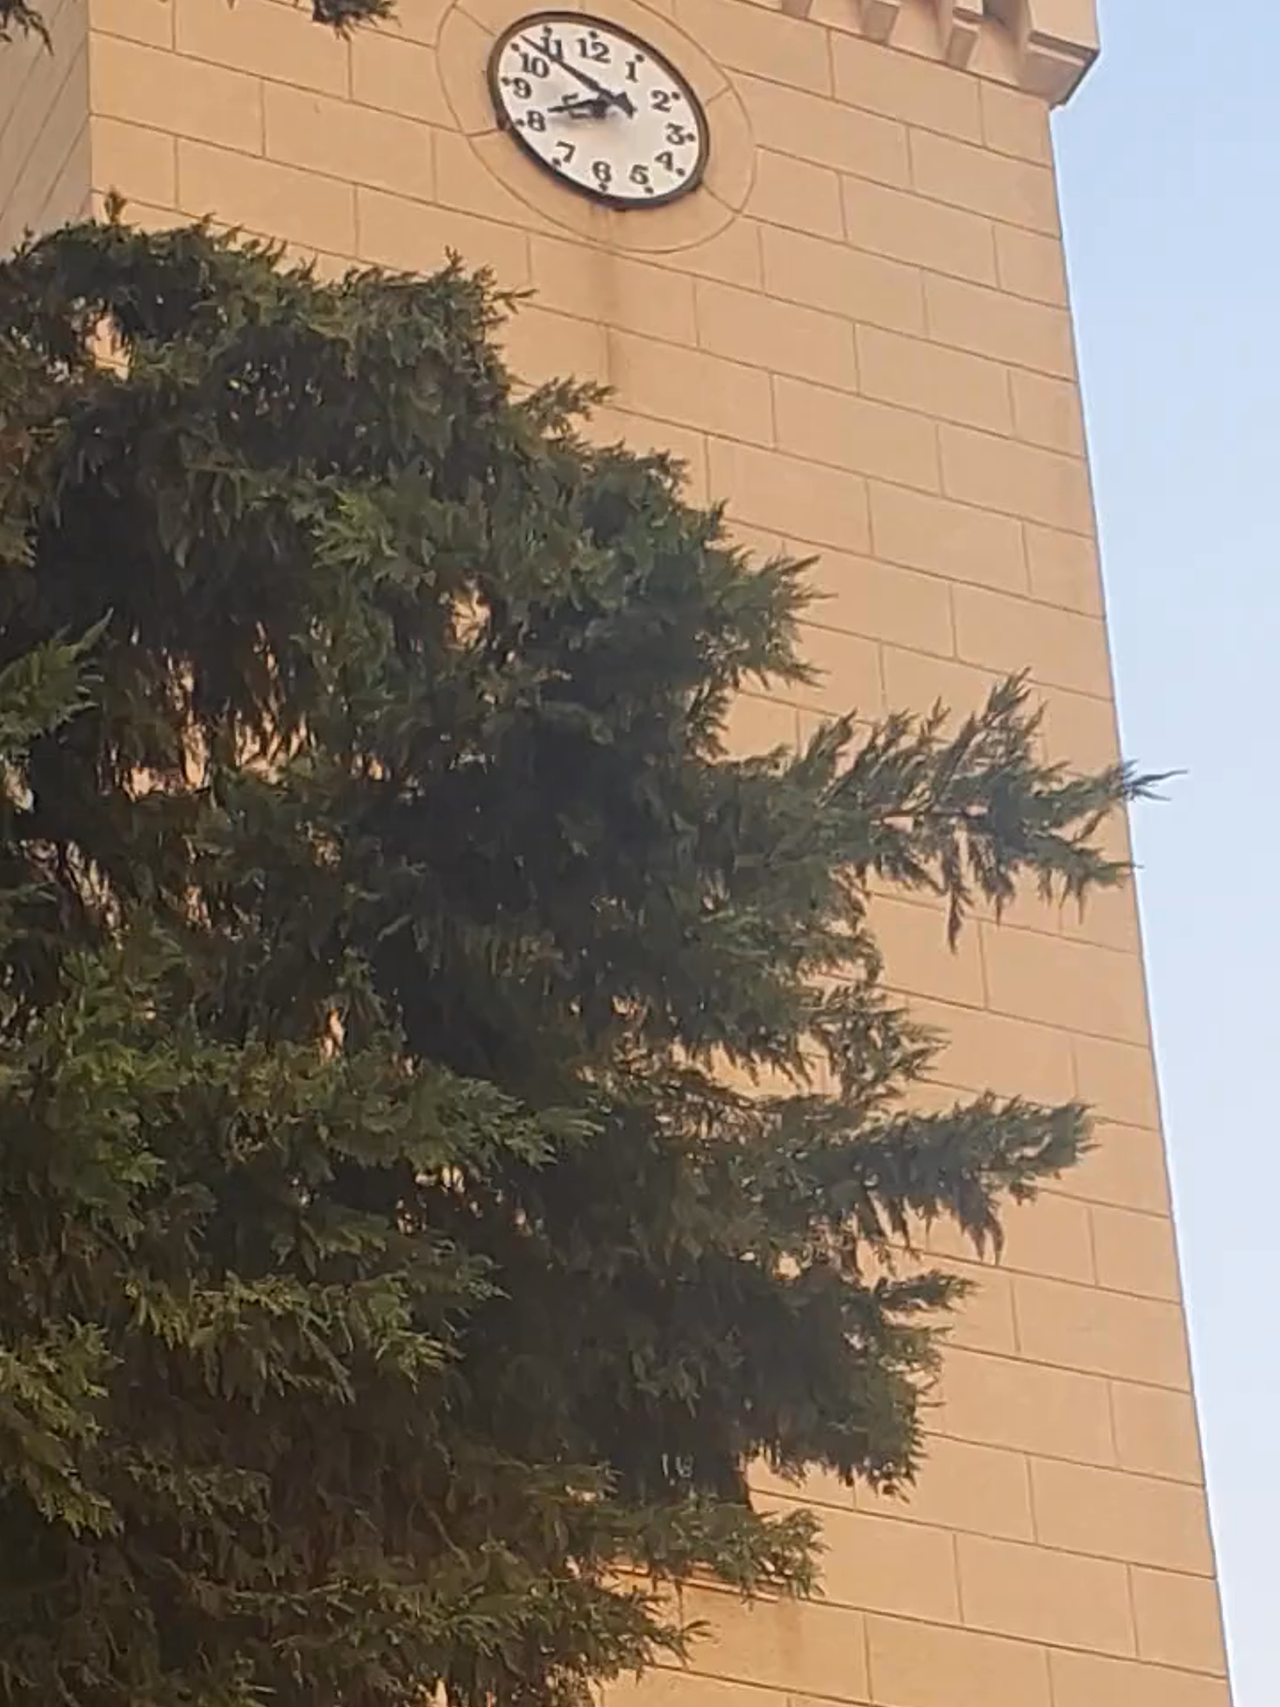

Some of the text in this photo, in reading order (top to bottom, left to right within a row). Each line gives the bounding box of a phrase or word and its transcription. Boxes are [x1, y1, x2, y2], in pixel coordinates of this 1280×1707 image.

[540, 36, 564, 62] 11
[577, 38, 611, 64] 12
[519, 53, 550, 78] 10
[625, 60, 638, 83] 1
[512, 77, 532, 99] 9
[651, 90, 671, 113] 2
[526, 110, 546, 132] 8
[665, 123, 688, 146] 3
[556, 141, 576, 163] 7
[654, 151, 674, 173] 4
[592, 161, 612, 183] 6
[629, 164, 649, 186] 5
